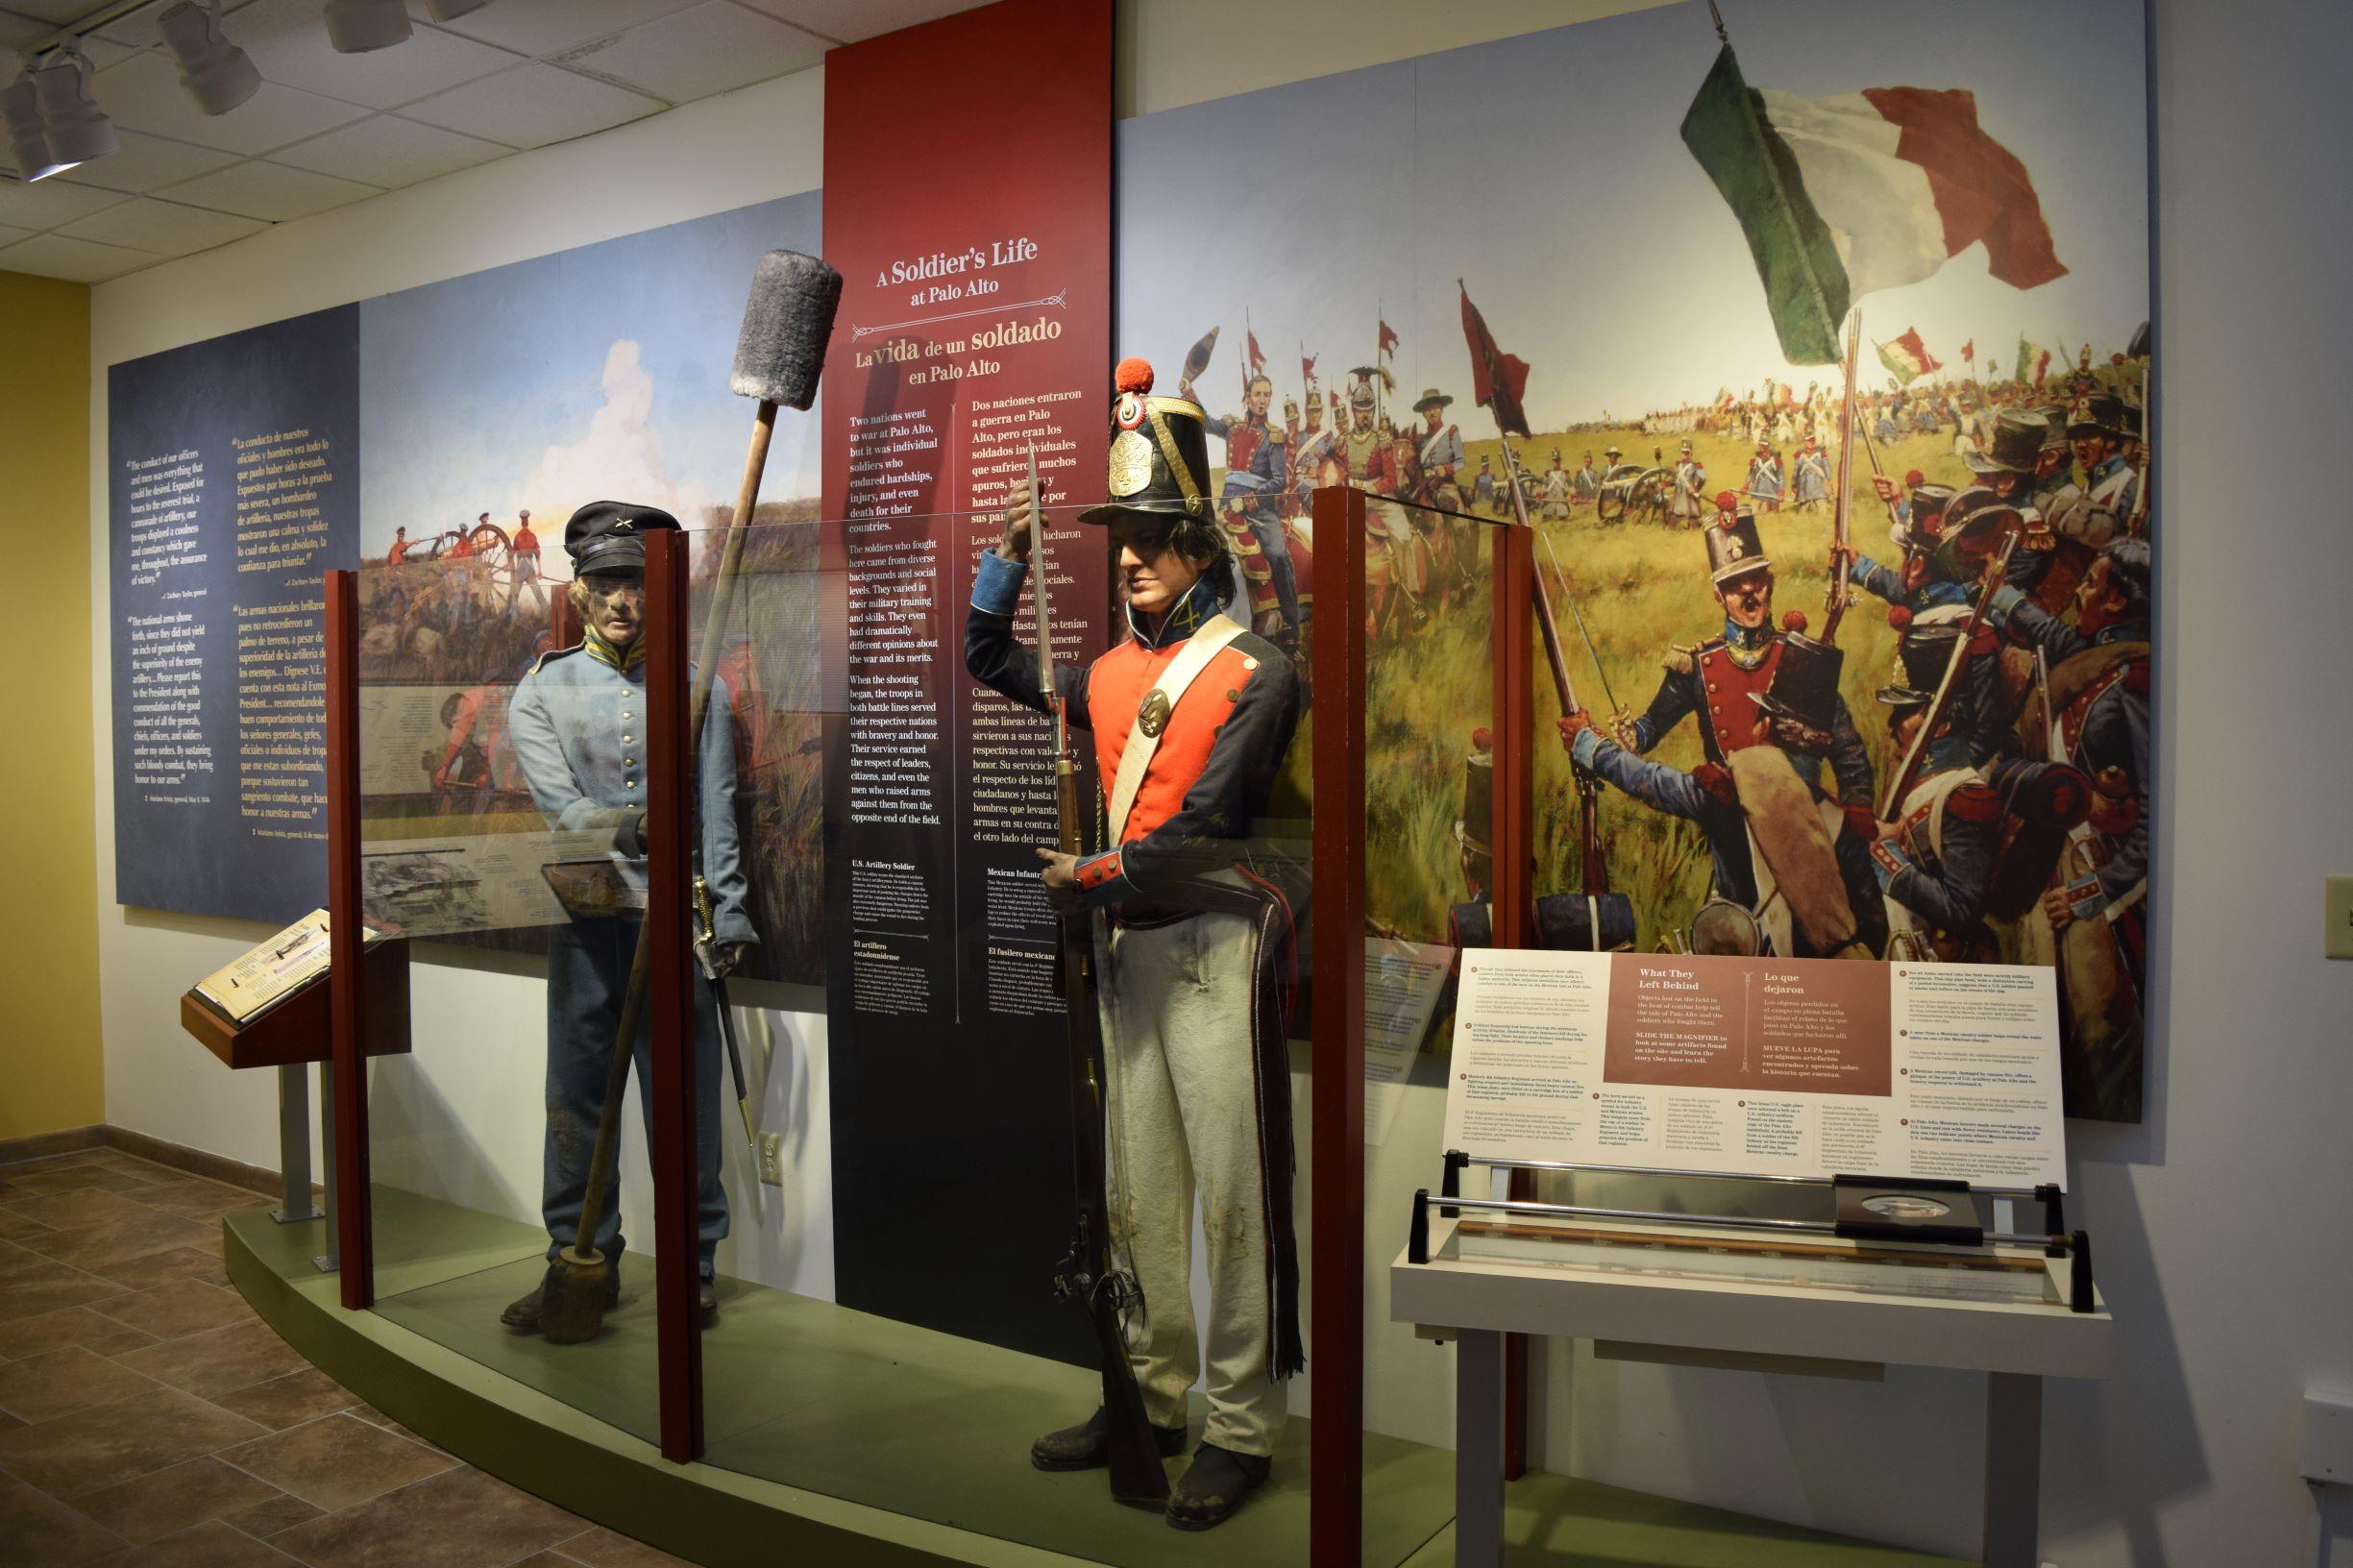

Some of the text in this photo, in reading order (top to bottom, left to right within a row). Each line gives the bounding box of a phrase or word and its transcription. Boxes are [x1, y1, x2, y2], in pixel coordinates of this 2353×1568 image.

[876, 237, 1038, 287] A Soldier's Life
[911, 279, 999, 306] at Palo Alto
[855, 316, 1061, 368] La vida de un soldado
[909, 359, 1000, 384] en Palo Alto
[972, 389, 1081, 411] Dos naciones entraron
[849, 408, 925, 427] Two nations went
[979, 415, 1012, 429] guerra
[1014, 414, 1025, 423] en
[1028, 408, 1050, 421] Palo
[849, 423, 933, 442] to war at Palo Alto,
[971, 424, 1061, 447] Alto, pero eran los
[849, 438, 937, 457] but it was individual
[971, 445, 1013, 459] soldados
[848, 457, 902, 473] soldiers who
[971, 465, 989, 477] que
[1039, 455, 1076, 469] muchos
[849, 470, 932, 487] endured hardships,
[850, 488, 918, 505] injury, and even
[848, 502, 912, 518] death for their
[848, 520, 891, 532] countries.
[848, 538, 937, 554] The soldiers who fought
[848, 567, 936, 584] backgrounds and social
[849, 674, 918, 687] When the shooting
[849, 701, 936, 712] both battle lines served
[972, 701, 1023, 715] disparos, las
[850, 715, 937, 728] their respective nations
[972, 716, 1037, 726] ambas líneas de
[850, 729, 938, 743] with bravery and honor.
[850, 743, 925, 753] Their service earned
[973, 744, 1017, 758] respectivas
[972, 759, 1043, 771] honor. Su servicio
[973, 801, 1024, 817] hombres que
[851, 811, 940, 825] opposite end of the field.
[973, 829, 1060, 847] el otro lado del camp
[852, 859, 915, 870] U.S. Artillery Soldier
[987, 868, 1043, 879] Mexican Infantr
[861, 941, 886, 949] artillero
[853, 949, 899, 961] estadounidense
[996, 947, 1022, 957] fusilero
[1024, 950, 1054, 960] mexican
[1640, 968, 1693, 979] What They
[1764, 972, 1777, 981] Lo
[1639, 980, 1698, 990] Left Behind
[1764, 985, 1803, 995] dejaron
